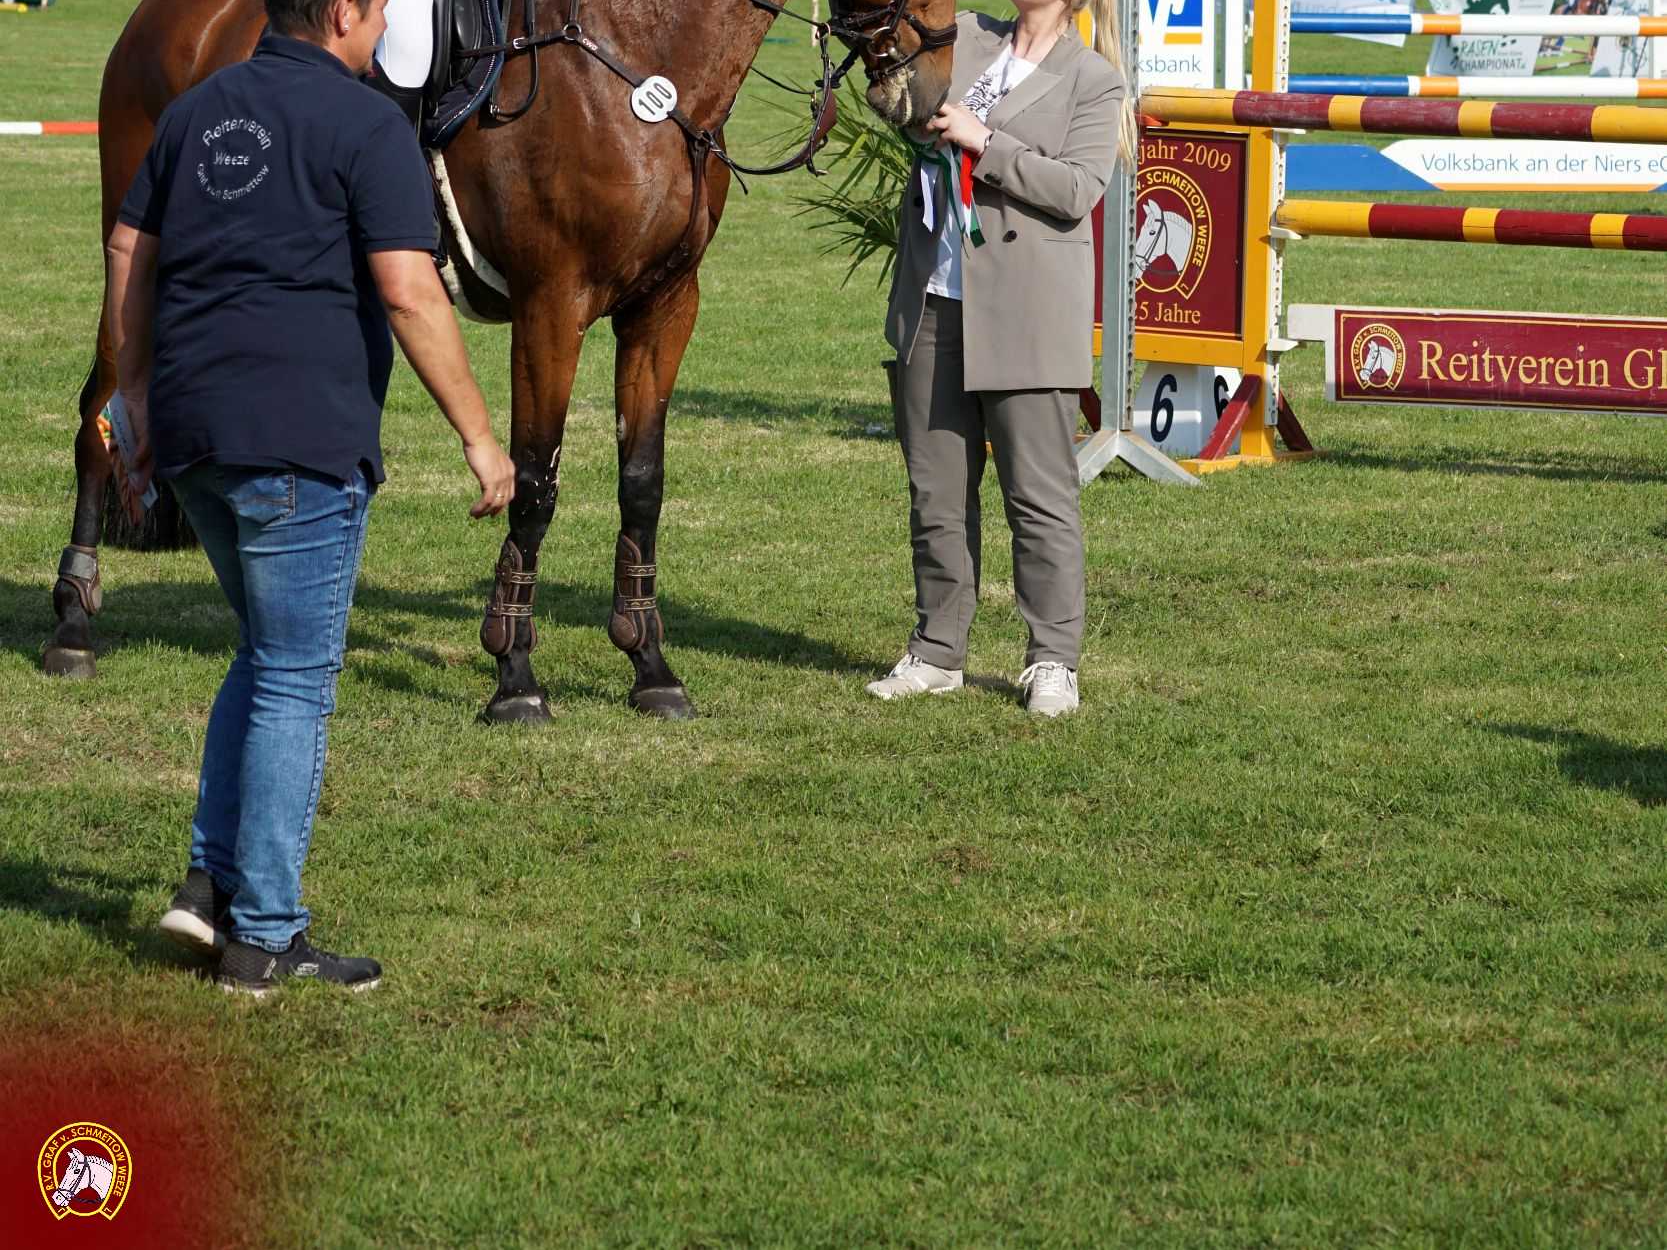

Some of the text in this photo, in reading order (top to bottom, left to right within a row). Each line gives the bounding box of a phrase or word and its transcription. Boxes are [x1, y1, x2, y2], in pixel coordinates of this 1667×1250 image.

[639, 82, 672, 116] 100
[202, 119, 272, 150] Reiterverein
[213, 150, 250, 166] Weeze
[1138, 138, 1232, 172] jahr 2009
[1421, 154, 1519, 172] Volksbank
[1526, 158, 1549, 172] an
[1556, 154, 1588, 173] der
[1594, 154, 1641, 173] Niers
[1146, 171, 1206, 218] SCHMETTOW
[1192, 224, 1208, 267] WEEZE
[1154, 302, 1201, 324] Jahre
[1418, 340, 1611, 388] Reitverein
[1151, 373, 1178, 443] 6
